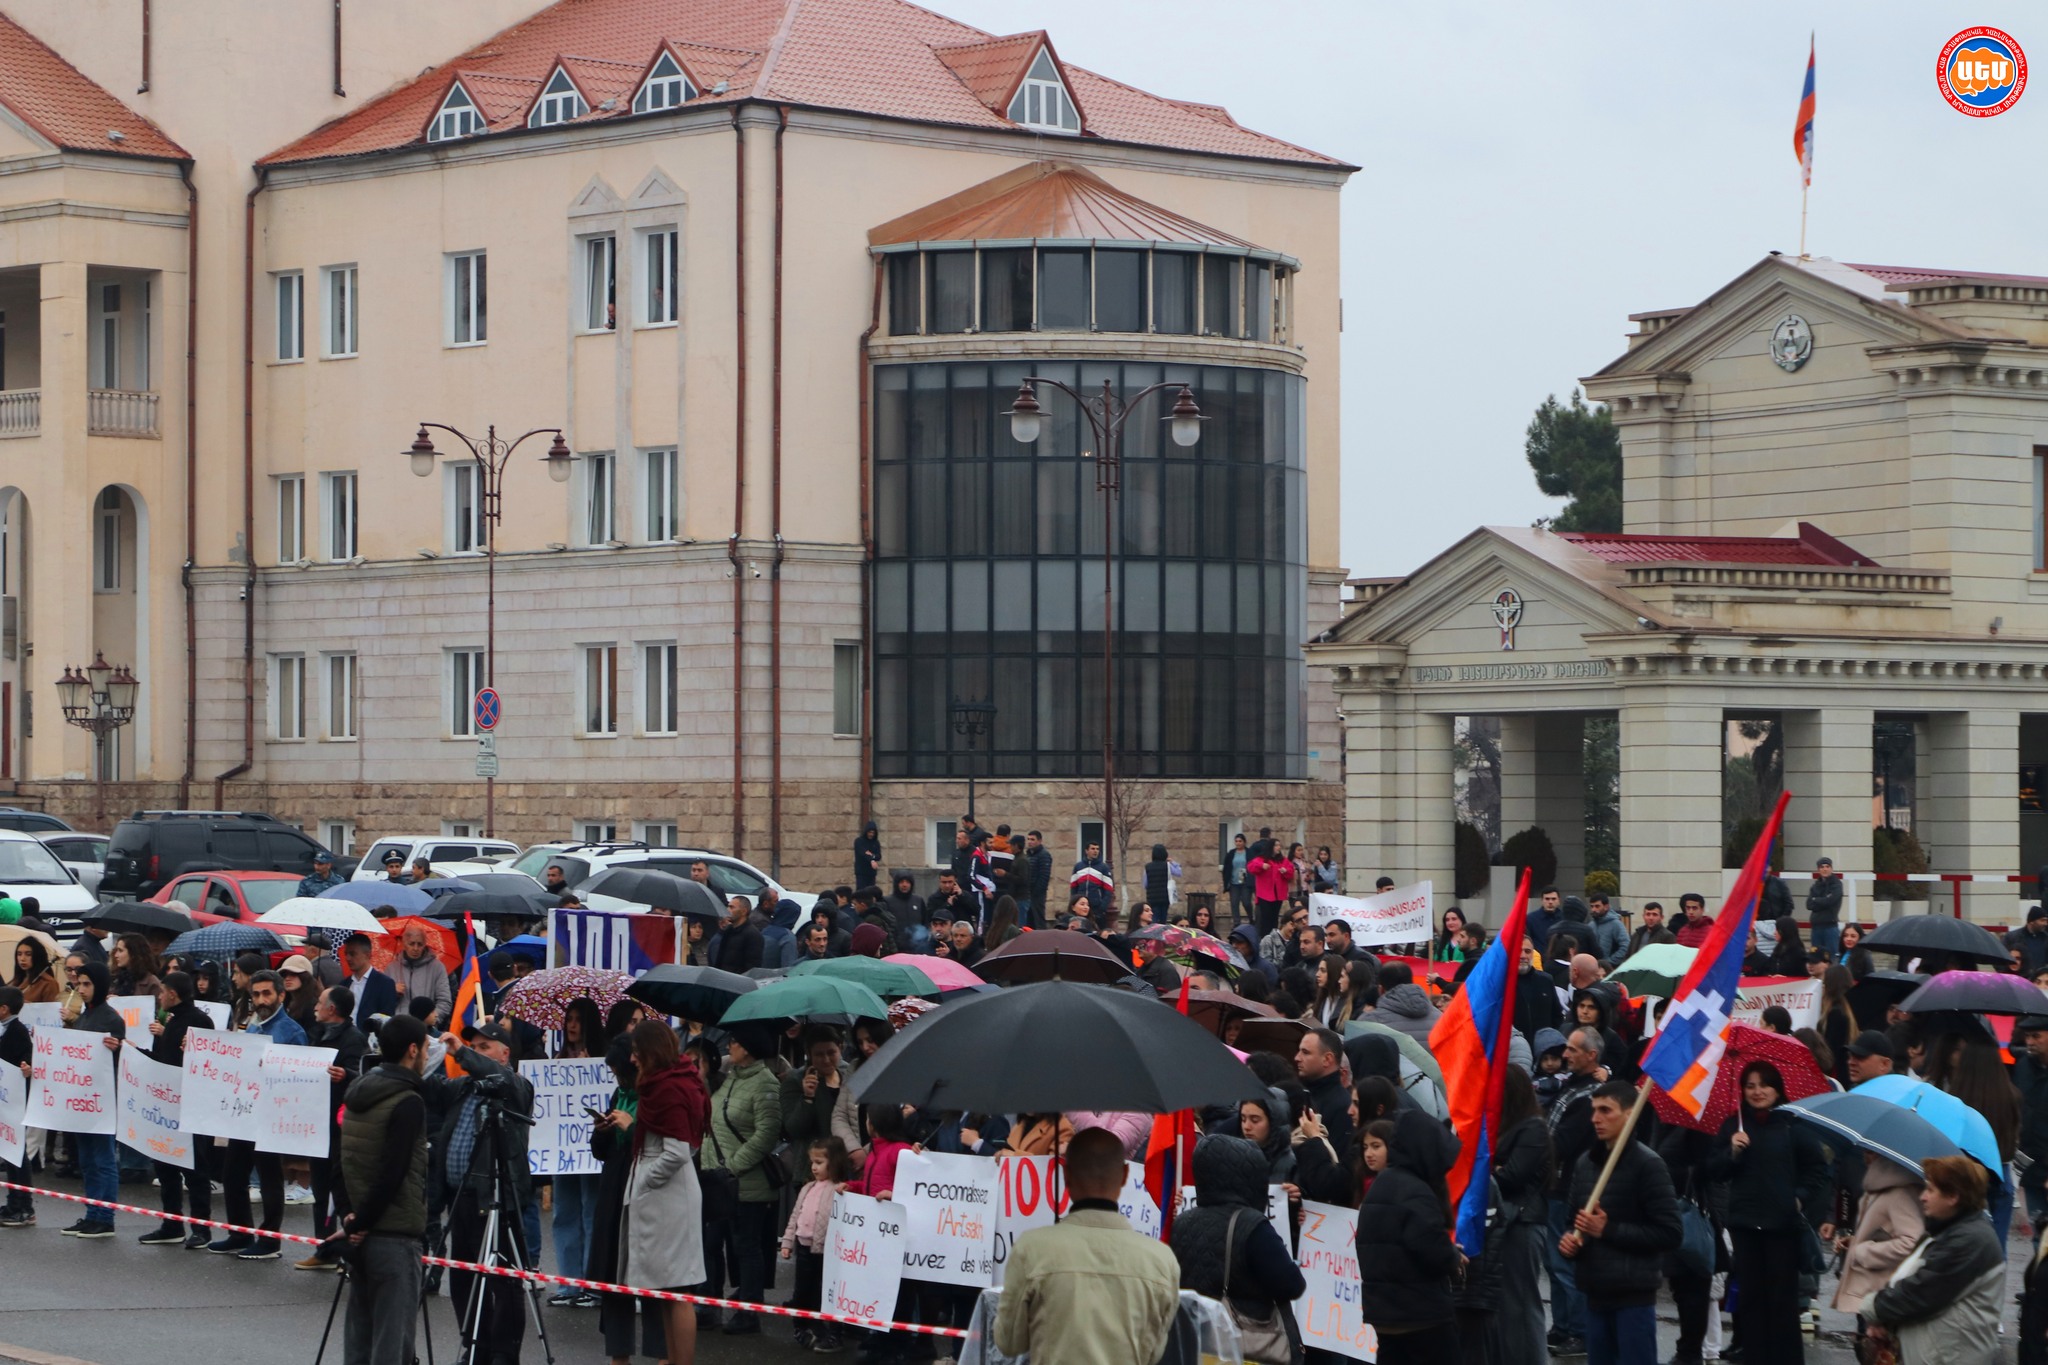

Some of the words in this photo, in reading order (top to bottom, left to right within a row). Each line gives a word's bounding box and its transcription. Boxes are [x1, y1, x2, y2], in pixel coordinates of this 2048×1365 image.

[36, 1036, 53, 1055] We
[61, 1043, 93, 1060] resist
[188, 1028, 242, 1058] Resistance
[33, 1061, 46, 1079] and
[53, 1065, 92, 1086] continue
[203, 1059, 218, 1080] the
[223, 1071, 241, 1094] only
[43, 1086, 54, 1106] to
[66, 1092, 102, 1112] resist
[221, 1097, 229, 1110] to
[533, 1095, 553, 1119] ST
[558, 1094, 574, 1117] LE
[558, 1124, 593, 1146] MOYE
[528, 1150, 549, 1173] SE
[1141, 1204, 1150, 1223] is
[879, 1221, 899, 1237] que
[961, 1247, 975, 1273] des
